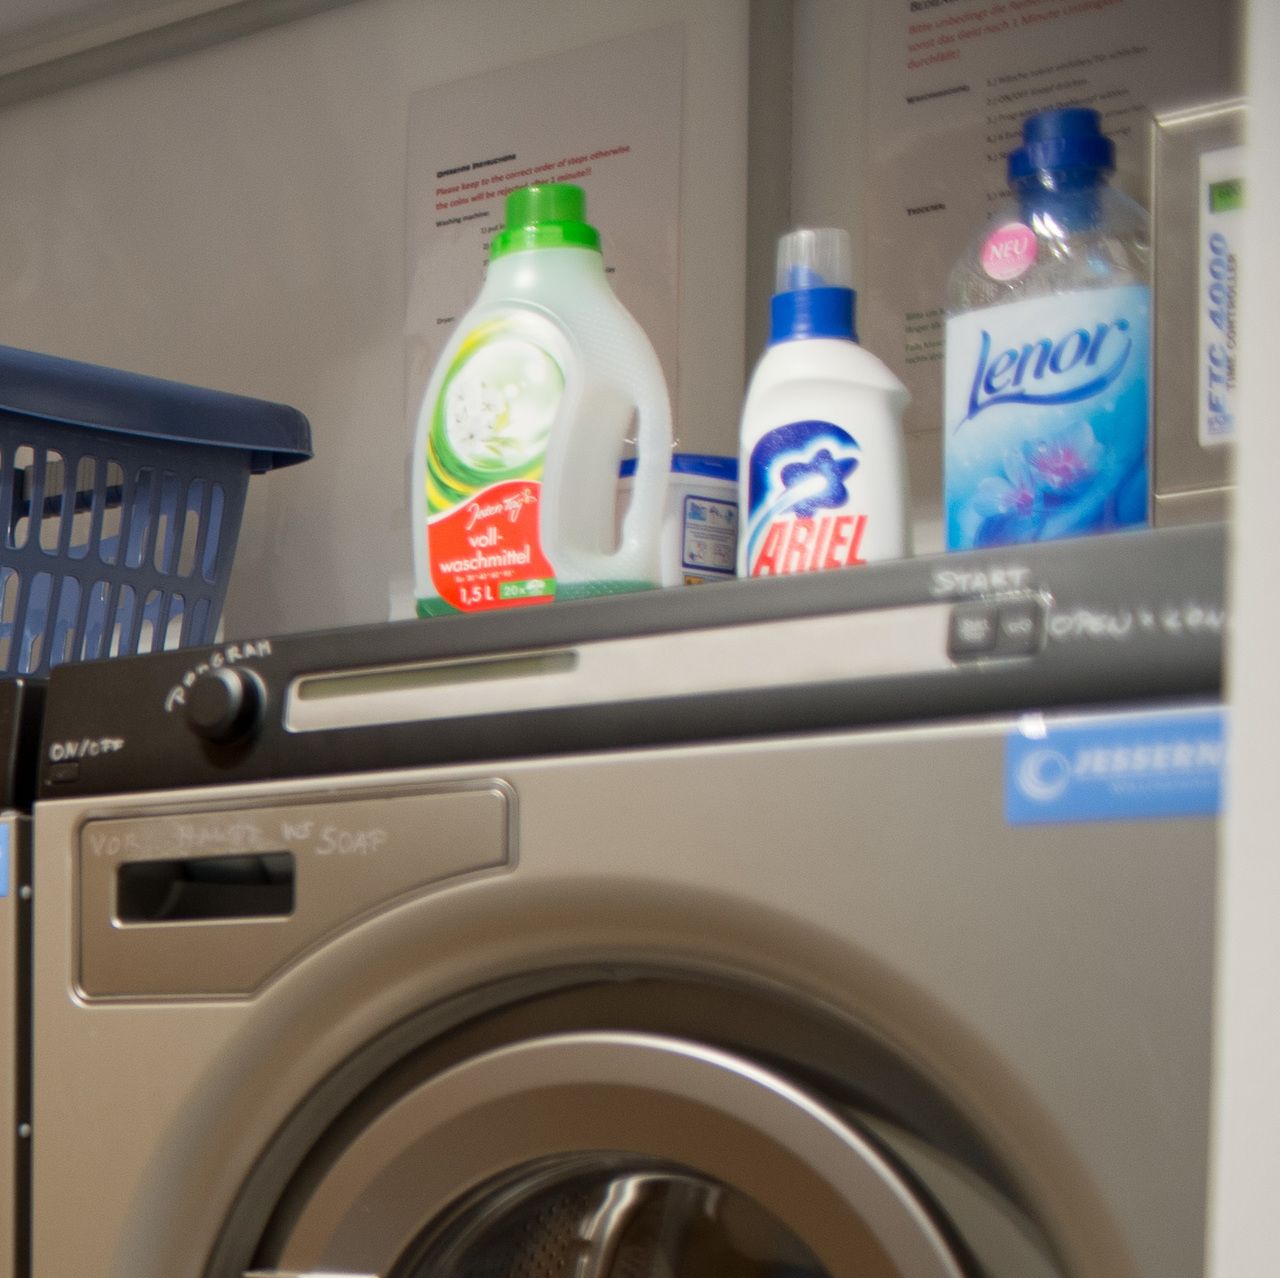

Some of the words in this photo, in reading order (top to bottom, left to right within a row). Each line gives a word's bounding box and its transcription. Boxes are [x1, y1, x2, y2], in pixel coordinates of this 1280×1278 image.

[436, 184, 459, 196] Please
[461, 180, 479, 191] keep
[481, 177, 489, 185] to
[491, 174, 503, 183] the
[505, 167, 532, 179] correct
[534, 161, 555, 172] order
[567, 154, 587, 166] steps
[590, 144, 629, 160] otherwise
[436, 200, 448, 209] the
[449, 196, 469, 207] coins
[471, 192, 483, 202] will
[485, 189, 495, 199] be
[991, 236, 1028, 259] NEU
[1207, 232, 1228, 331] 4000
[1226, 253, 1238, 350] CONTROLLER
[1207, 343, 1228, 414] FTC
[1226, 355, 1238, 390] TIME
[468, 527, 504, 548] voll-
[751, 514, 868, 579] ARIEL
[439, 544, 531, 573] waschmittel
[459, 585, 482, 605] 1,5
[483, 583, 494, 601] L
[928, 567, 1032, 597] START
[48, 737, 125, 762] ON/OFF
